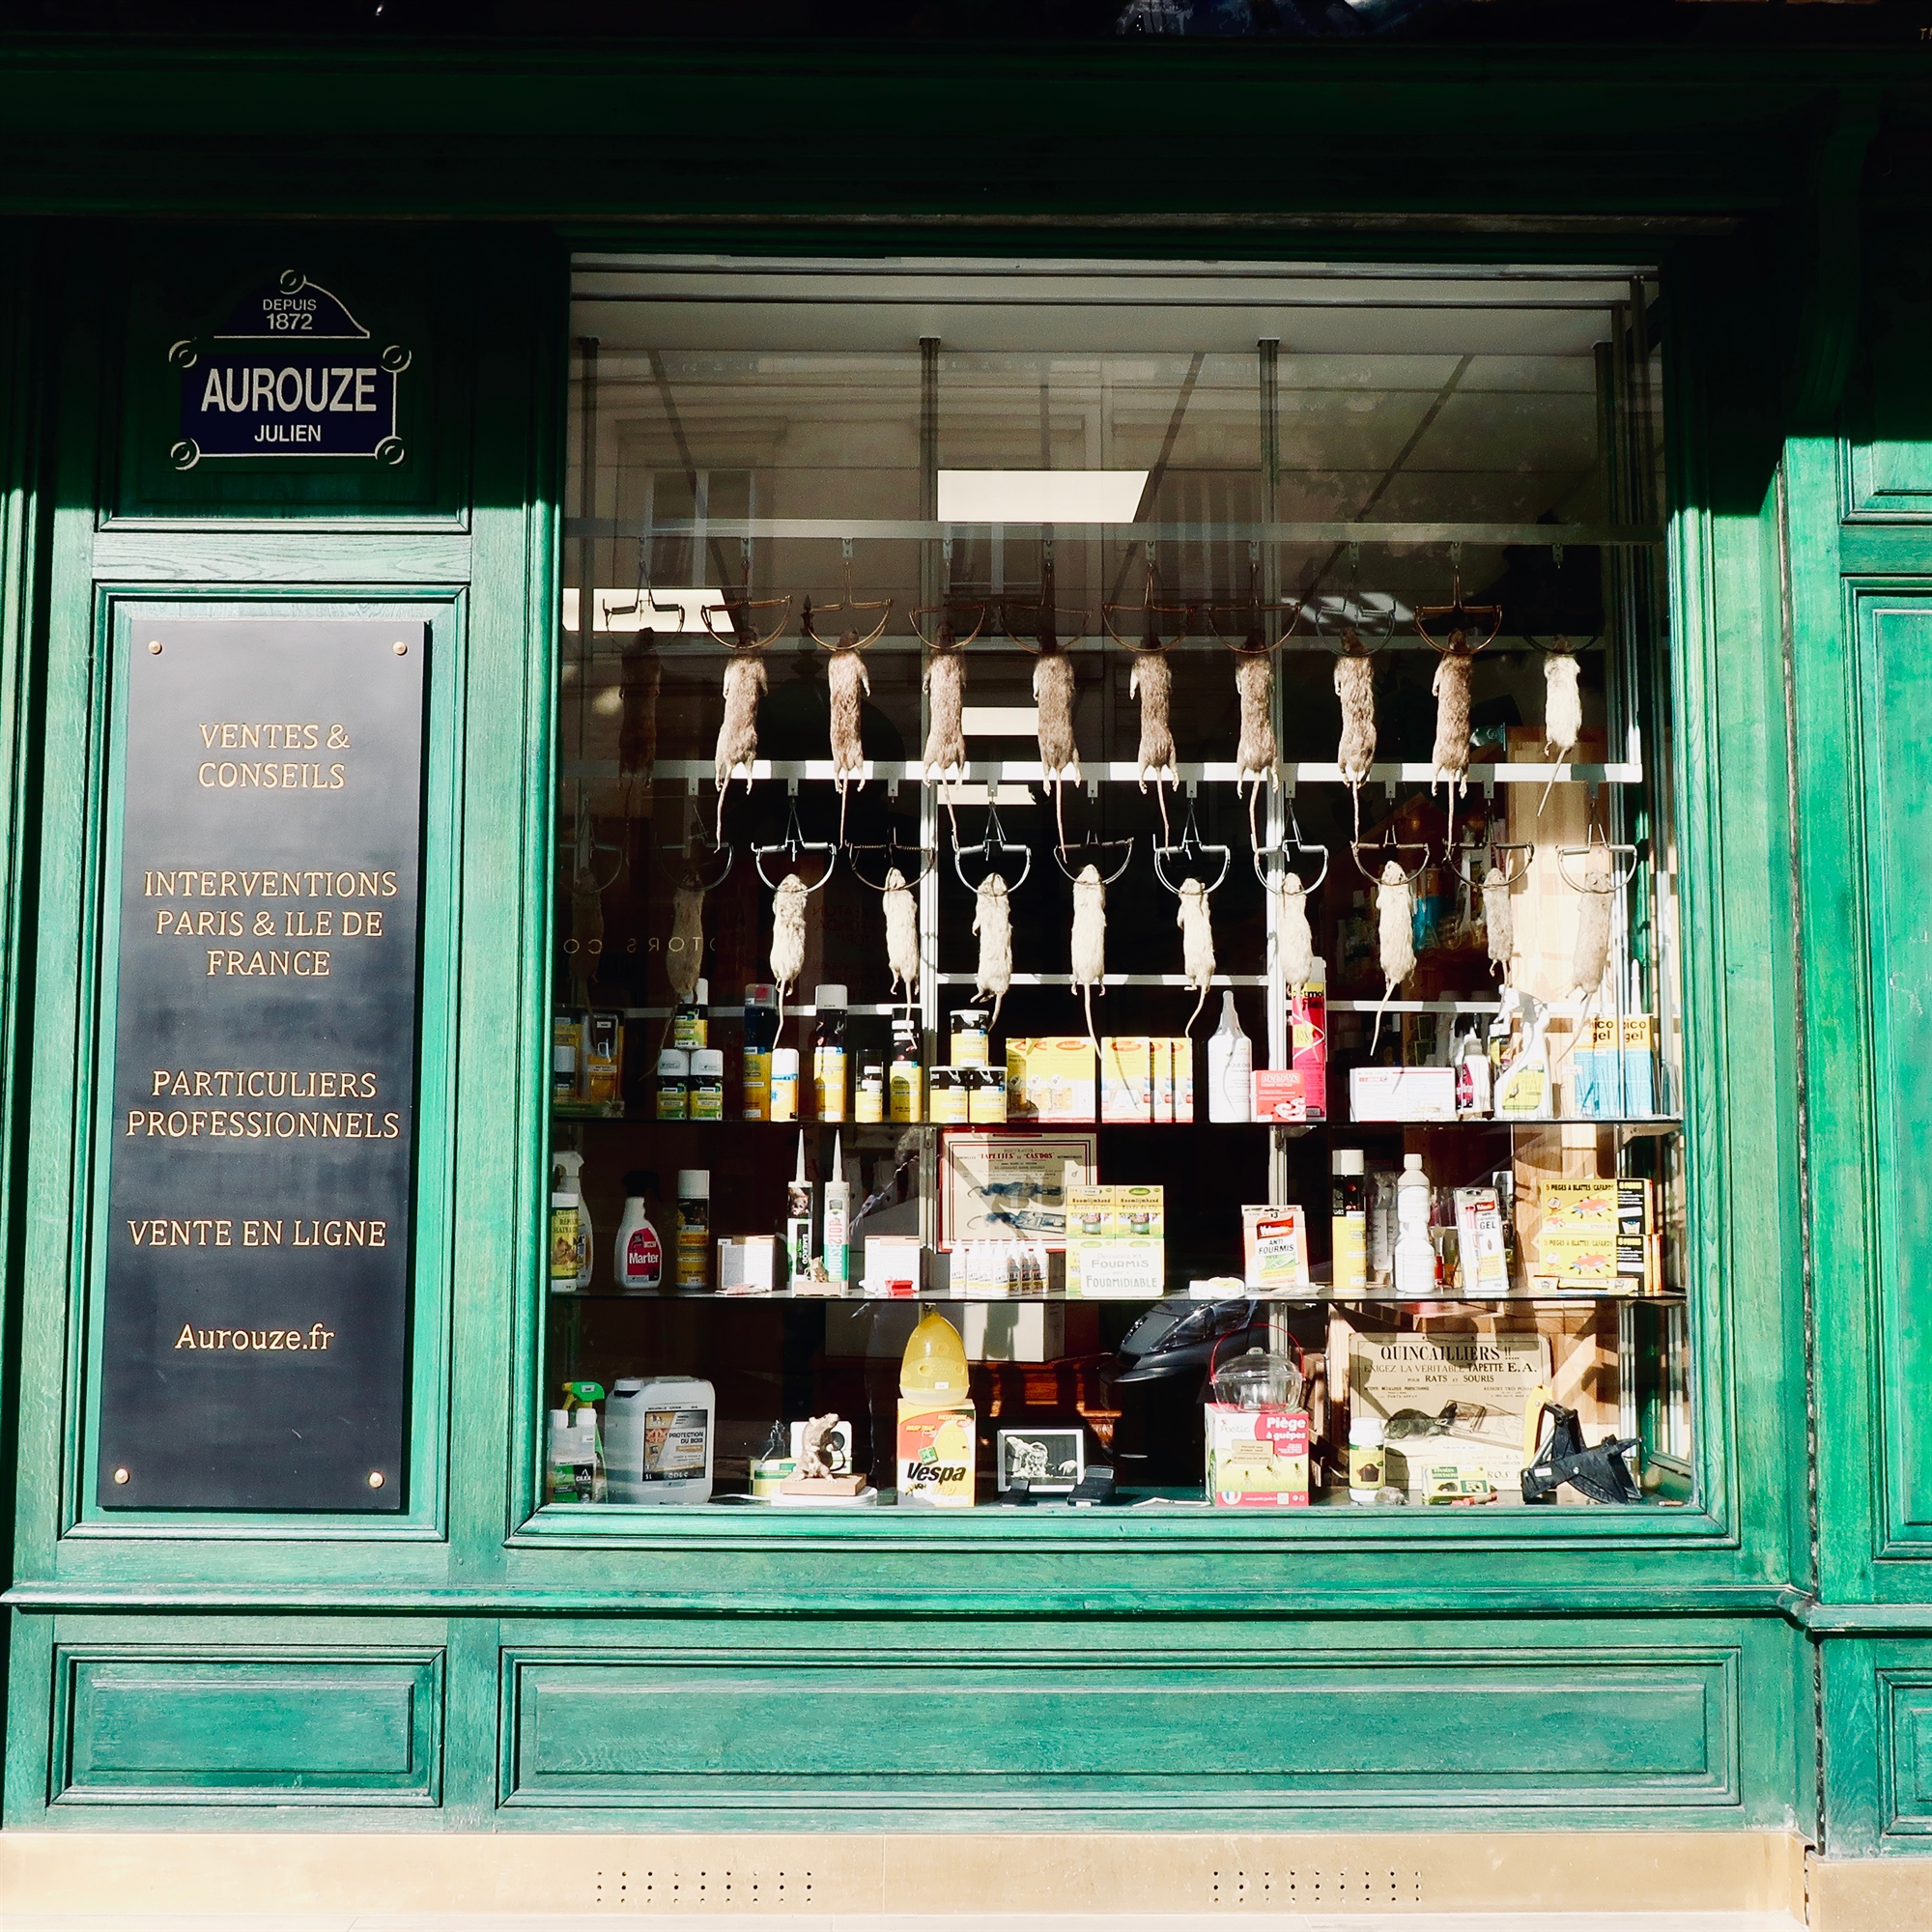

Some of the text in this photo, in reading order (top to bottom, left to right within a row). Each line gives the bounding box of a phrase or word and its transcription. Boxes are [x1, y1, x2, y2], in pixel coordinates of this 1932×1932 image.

[263, 298, 317, 311] DEPUIS
[266, 313, 313, 330] 1872
[200, 367, 378, 412] AUROUZE
[254, 424, 322, 442] JULIEN
[198, 723, 351, 751] VENTES &
[197, 761, 346, 790] CONSEILS
[143, 870, 398, 898] INTERVENTIONS
[155, 910, 384, 937] PARIS & ILE DE
[206, 950, 331, 977] FRANCE
[1593, 1030, 1610, 1042] gel
[1625, 1030, 1643, 1043] gel
[151, 1069, 377, 1098] PARTICULIERS
[126, 1111, 400, 1139] PROFESSIONNELS
[127, 1220, 386, 1247] VENTE EN LIGNE
[1479, 1221, 1496, 1230] GEL
[1259, 1244, 1294, 1255] FOURMIS
[629, 1252, 660, 1264] Marter
[1091, 1260, 1150, 1268] FOURMIS
[1086, 1275, 1157, 1288] FOURMIDIABLE
[175, 1323, 335, 1350] Aurouze.fr
[1380, 1346, 1499, 1361] QUINCAILLIERS
[1467, 1362, 1504, 1373] TAPETTE
[1266, 1416, 1306, 1431] Piège
[668, 1431, 704, 1439] PROTECTION
[1273, 1432, 1306, 1441] guêpes
[907, 1463, 966, 1486] Vespa
